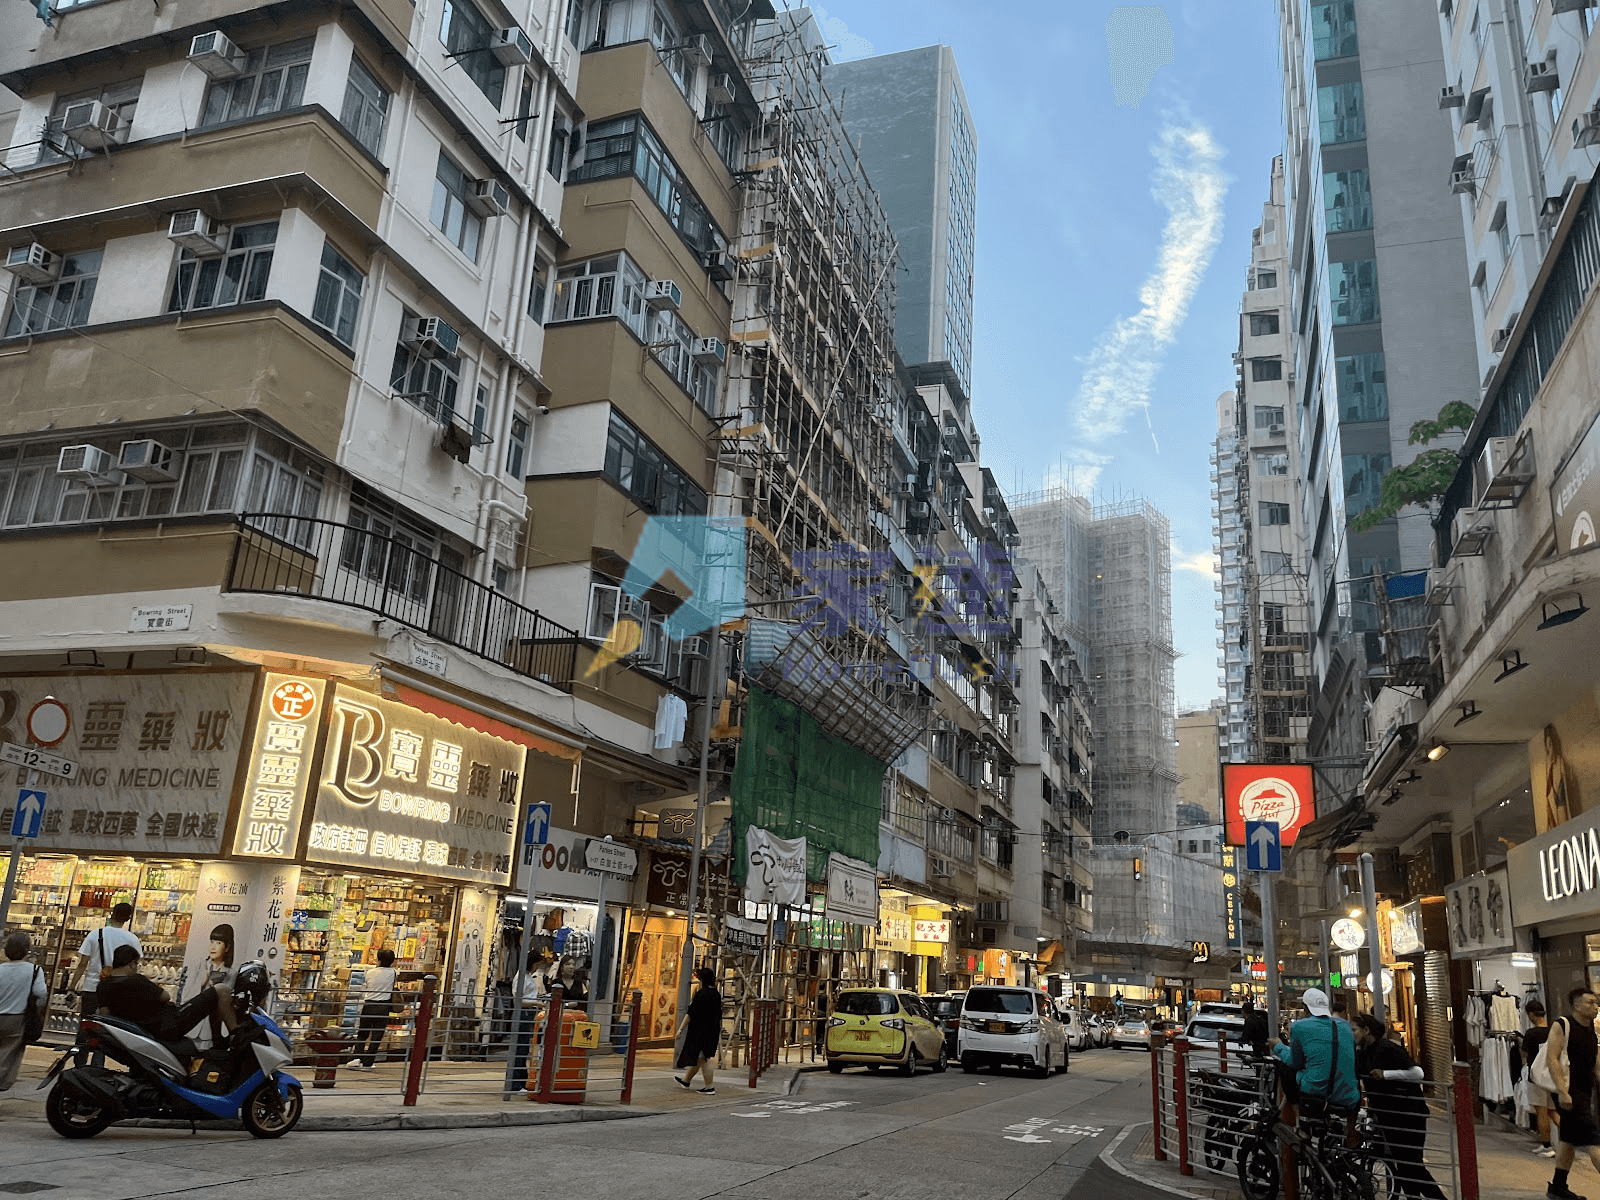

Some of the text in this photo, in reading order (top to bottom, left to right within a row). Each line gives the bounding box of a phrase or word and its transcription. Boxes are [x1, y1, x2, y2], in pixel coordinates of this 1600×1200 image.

[415, 656, 441, 671] 白加士街
[280, 697, 304, 716] 正
[27, 700, 232, 752] 靈藥妝
[62, 763, 72, 775] 9
[117, 768, 221, 789] MEDICINE
[385, 729, 519, 807] 寶靈藥妝
[243, 720, 308, 856] 寶靈藥妝
[378, 789, 515, 836] BOWRING MEDICINE
[1251, 799, 1285, 815] Pizza
[0, 808, 219, 839] 信証 環球西藥 全國快遞
[310, 822, 369, 855] 政府註冊
[370, 831, 422, 863] 信心保証
[599, 845, 626, 858] Parkes Street
[599, 858, 622, 870] 白加士街
[218, 882, 249, 896] 紫花油
[263, 875, 286, 943] 紫花油
[1226, 893, 1235, 940] CEYLON
